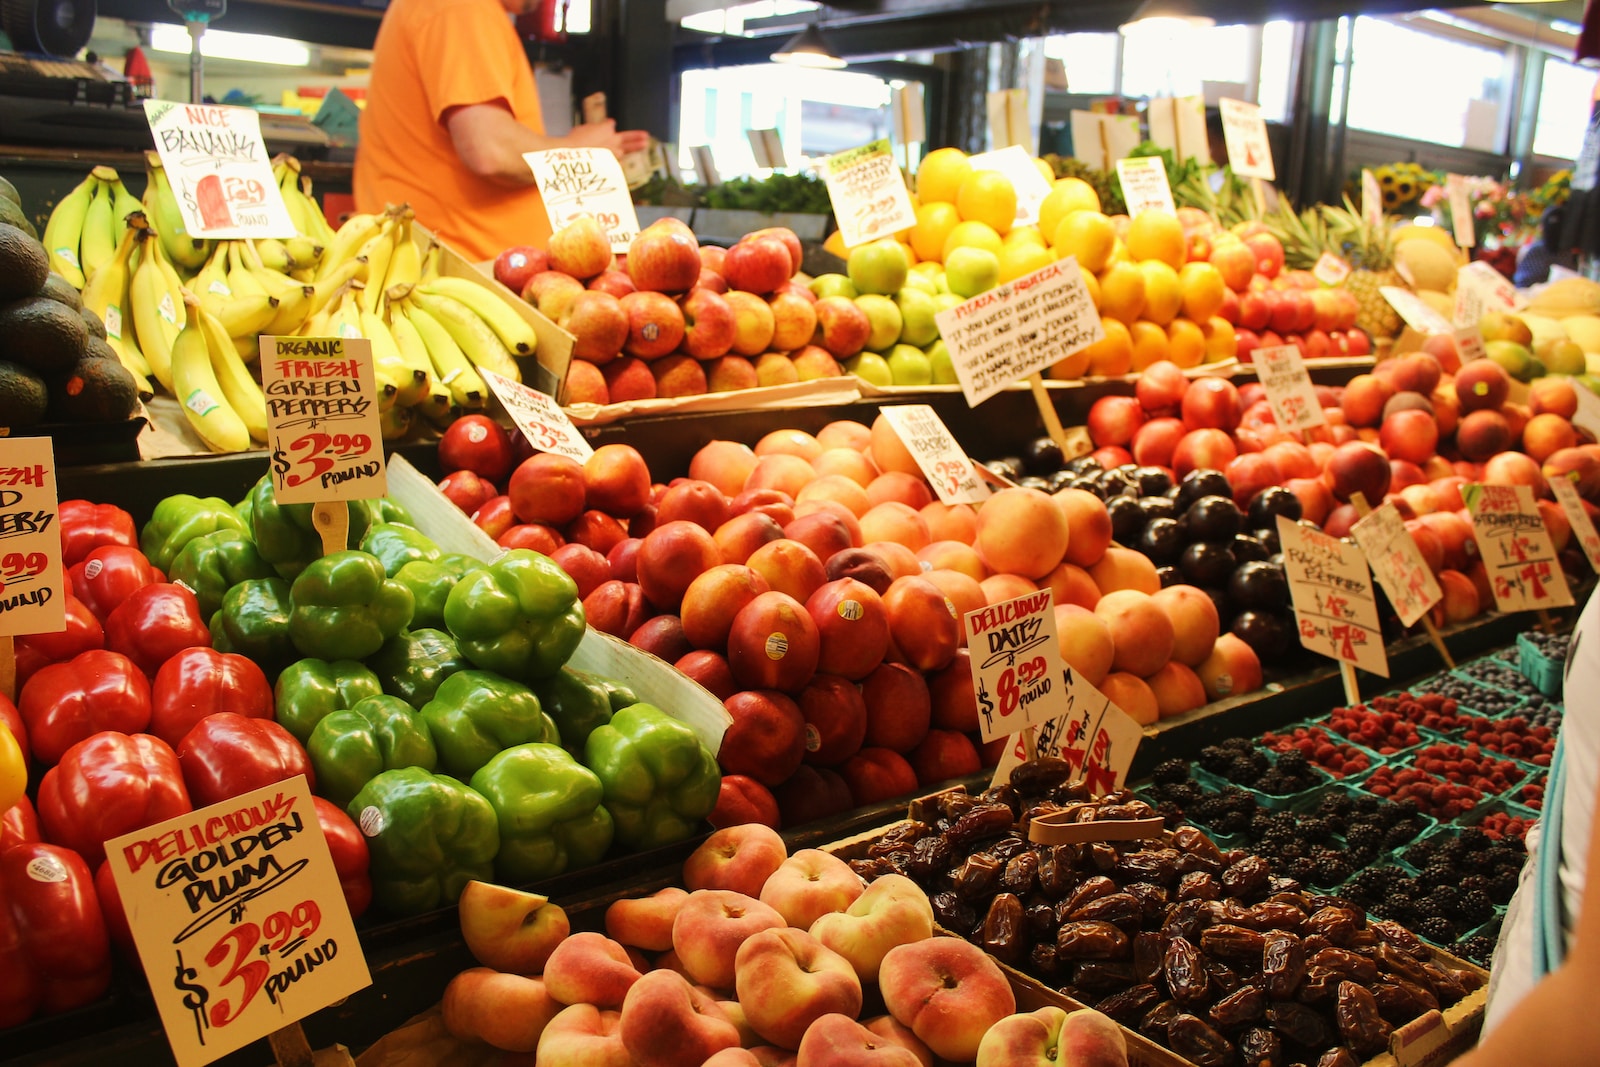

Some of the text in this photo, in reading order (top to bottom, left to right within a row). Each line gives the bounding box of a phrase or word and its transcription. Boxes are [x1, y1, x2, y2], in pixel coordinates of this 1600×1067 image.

[185, 106, 230, 128] NICE
[236, 213, 269, 227] POUND
[964, 320, 983, 335] YOU
[984, 307, 1013, 326] NEED
[1016, 296, 1039, 313] HELP
[958, 344, 966, 355] A
[1018, 310, 1040, 326] JUST
[275, 340, 343, 357] ORGANIC
[1012, 351, 1046, 375] READY
[1048, 347, 1060, 358] TO
[274, 359, 363, 379] FRESH
[986, 357, 1011, 373] NAME
[266, 379, 361, 397] GREEN
[266, 396, 371, 417] PEPPERS
[321, 461, 380, 488] POUND
[970, 592, 1050, 636] DELICIOUS
[988, 617, 1043, 654] DATES
[1019, 678, 1051, 710] POUND
[123, 793, 298, 874] DELICIOUS
[156, 811, 304, 889] GOLDEN
[182, 854, 284, 913] PLUM
[264, 938, 338, 1005] POUND
